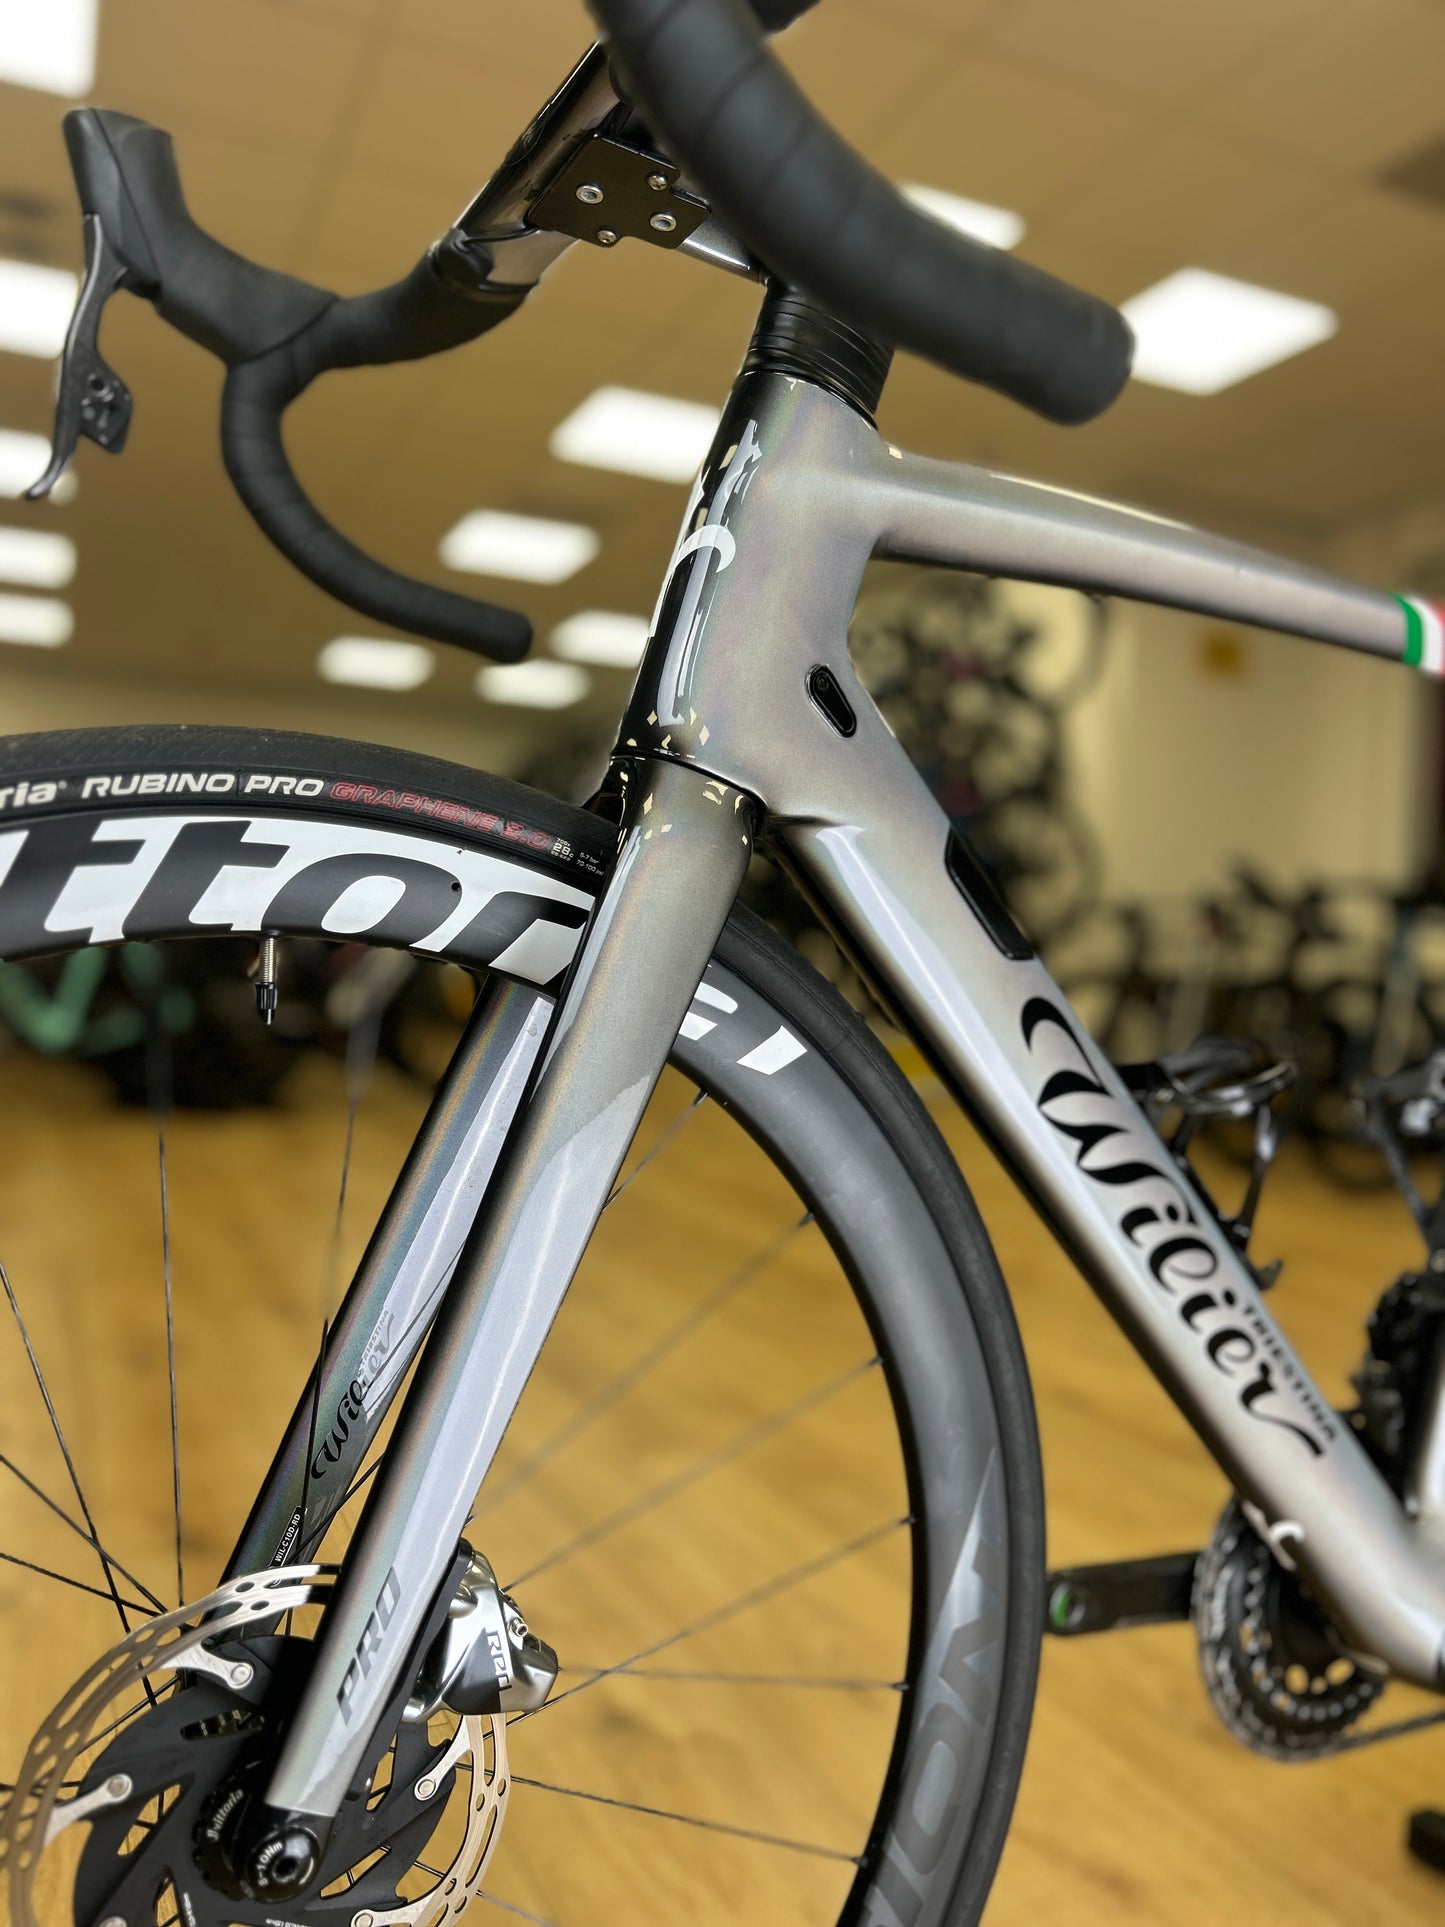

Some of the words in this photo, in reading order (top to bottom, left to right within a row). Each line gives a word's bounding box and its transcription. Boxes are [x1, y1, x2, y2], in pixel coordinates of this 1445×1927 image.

[82, 773, 235, 798] RUBINO
[245, 775, 324, 797] PRO
[329, 780, 500, 832] GRAPHENE
[499, 820, 552, 849] 2.0
[1020, 996, 1325, 1458] Wilier
[311, 1313, 395, 1479] Wilier
[336, 1566, 401, 1727] PRO
